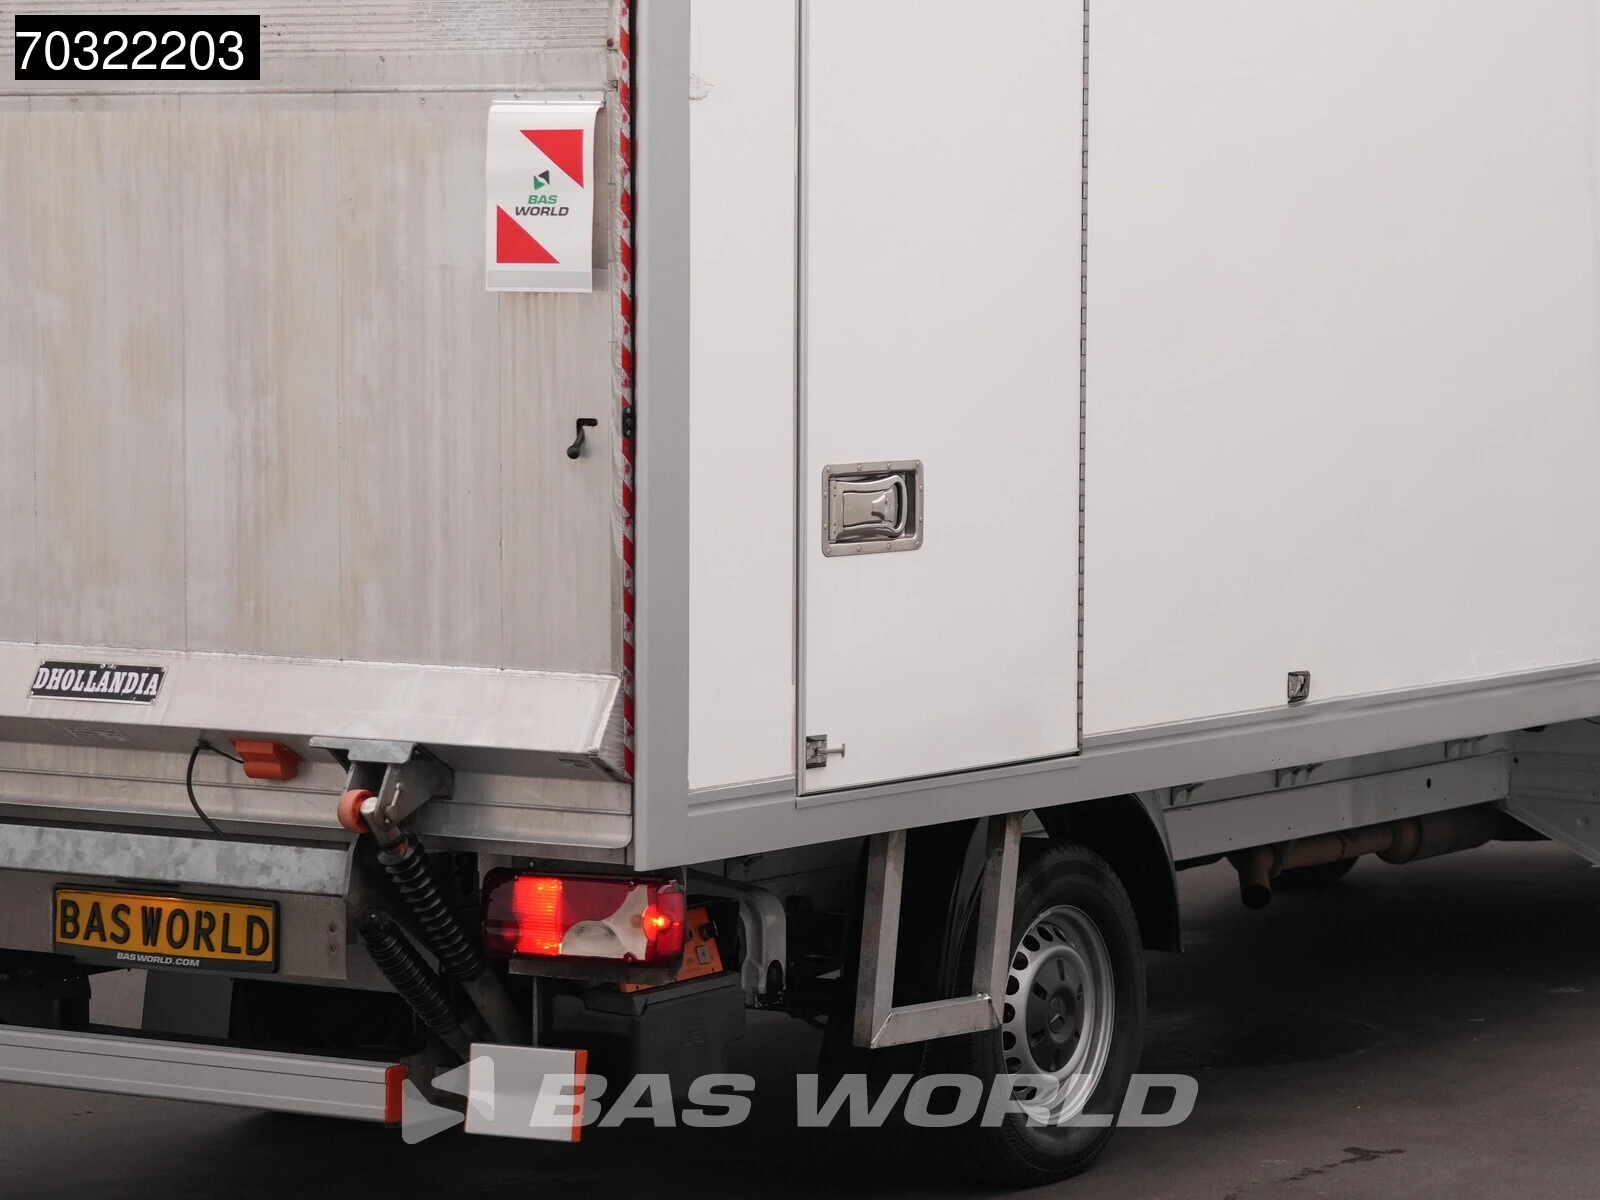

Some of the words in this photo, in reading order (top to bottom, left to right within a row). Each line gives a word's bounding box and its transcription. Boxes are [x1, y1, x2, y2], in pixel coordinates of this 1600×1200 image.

[528, 195, 558, 205] BAS
[515, 206, 570, 217] WORLD
[33, 667, 160, 696] DHOLLANDIA
[60, 899, 131, 945] BAS
[141, 906, 270, 956] WORLD
